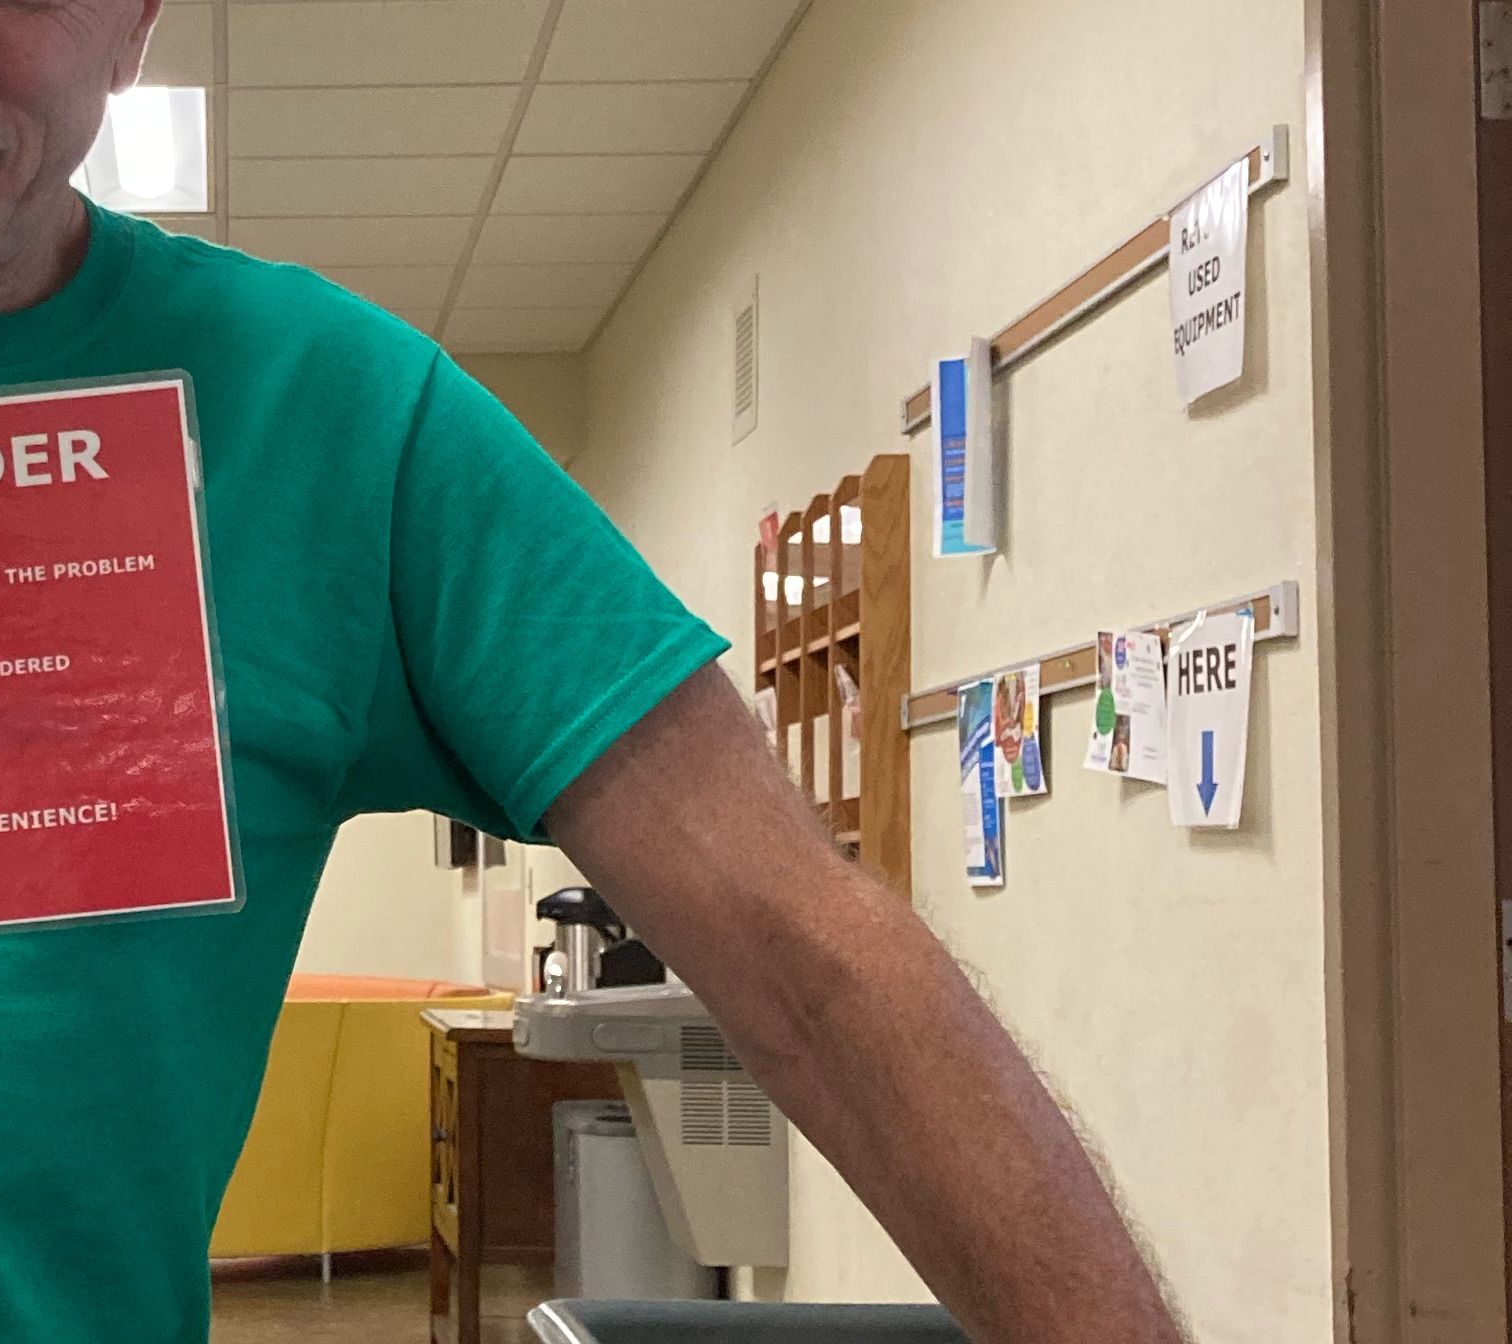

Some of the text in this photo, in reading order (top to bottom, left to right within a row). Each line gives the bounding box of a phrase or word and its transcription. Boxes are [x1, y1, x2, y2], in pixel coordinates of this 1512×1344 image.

[1188, 255, 1221, 296] USED
[1173, 290, 1241, 357] EQUIPMENT
[5, 565, 47, 584] THE
[53, 554, 155, 580] PROBLEM
[1178, 643, 1236, 696] HERE
